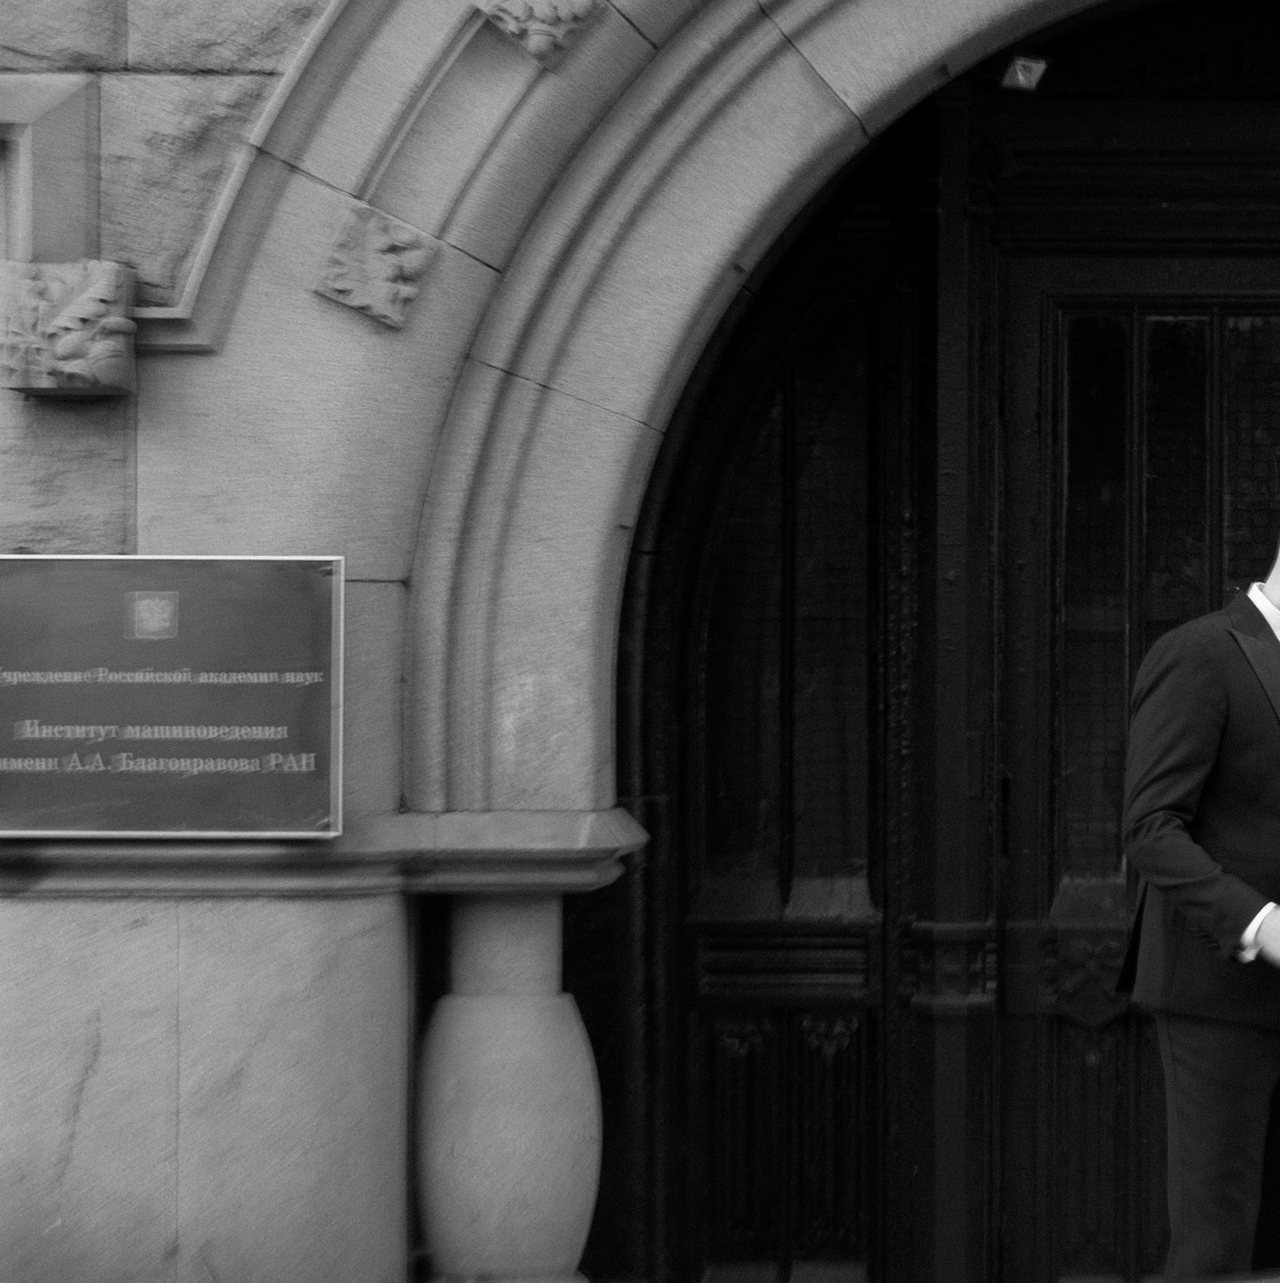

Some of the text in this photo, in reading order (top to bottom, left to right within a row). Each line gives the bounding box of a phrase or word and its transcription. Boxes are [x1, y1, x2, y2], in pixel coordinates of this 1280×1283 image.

[0, 667, 324, 686] чреждение Российской академии наук
[23, 719, 289, 742] Институт машиноведения
[120, 752, 261, 774] Благонравова
[269, 752, 317, 772] РАН
